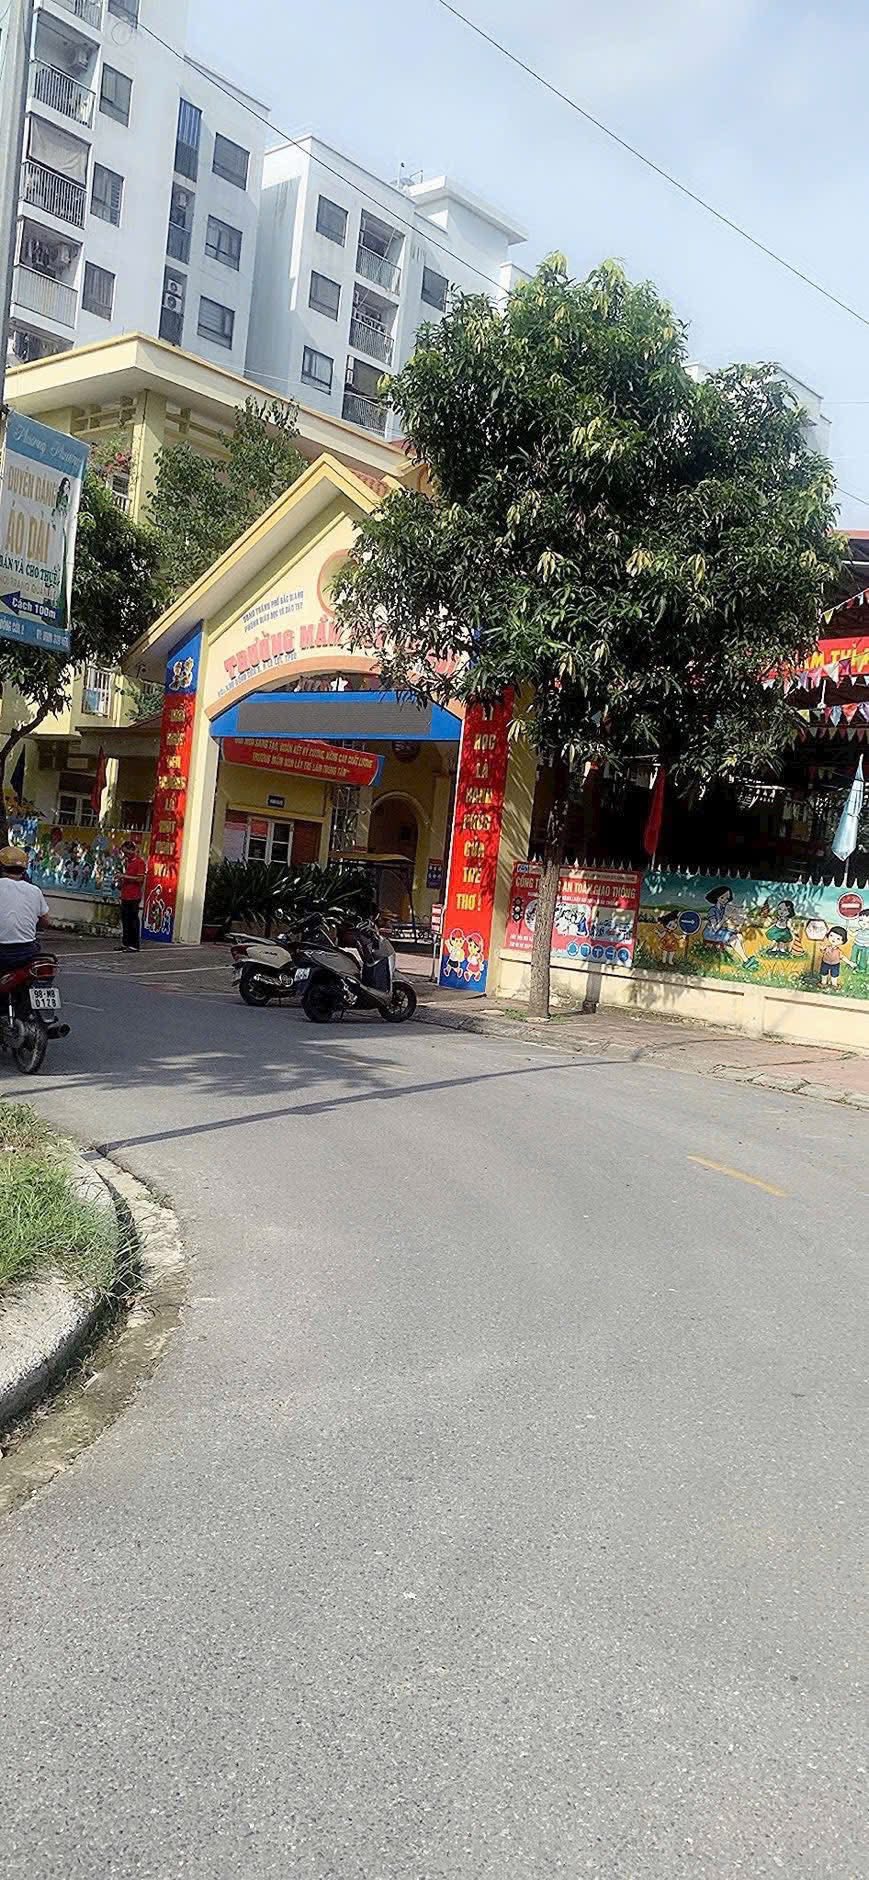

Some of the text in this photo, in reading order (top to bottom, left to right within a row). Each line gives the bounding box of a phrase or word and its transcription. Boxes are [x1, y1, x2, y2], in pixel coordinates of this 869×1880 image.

[7, 500, 48, 563] ÁO DÀI
[15, 559, 24, 574] VÀ
[26, 564, 39, 579] CHO
[12, 597, 56, 619] Cách 100m
[224, 630, 295, 680] TRƯỜNG
[474, 734, 496, 753] HỌC
[476, 758, 489, 779] LÀ
[464, 836, 485, 857] CỦA
[463, 862, 482, 883] TRẺ
[562, 881, 573, 893] AN
[574, 880, 592, 894] TOÀN
[593, 884, 611, 897] GIAO
[612, 886, 637, 899] THÔNG
